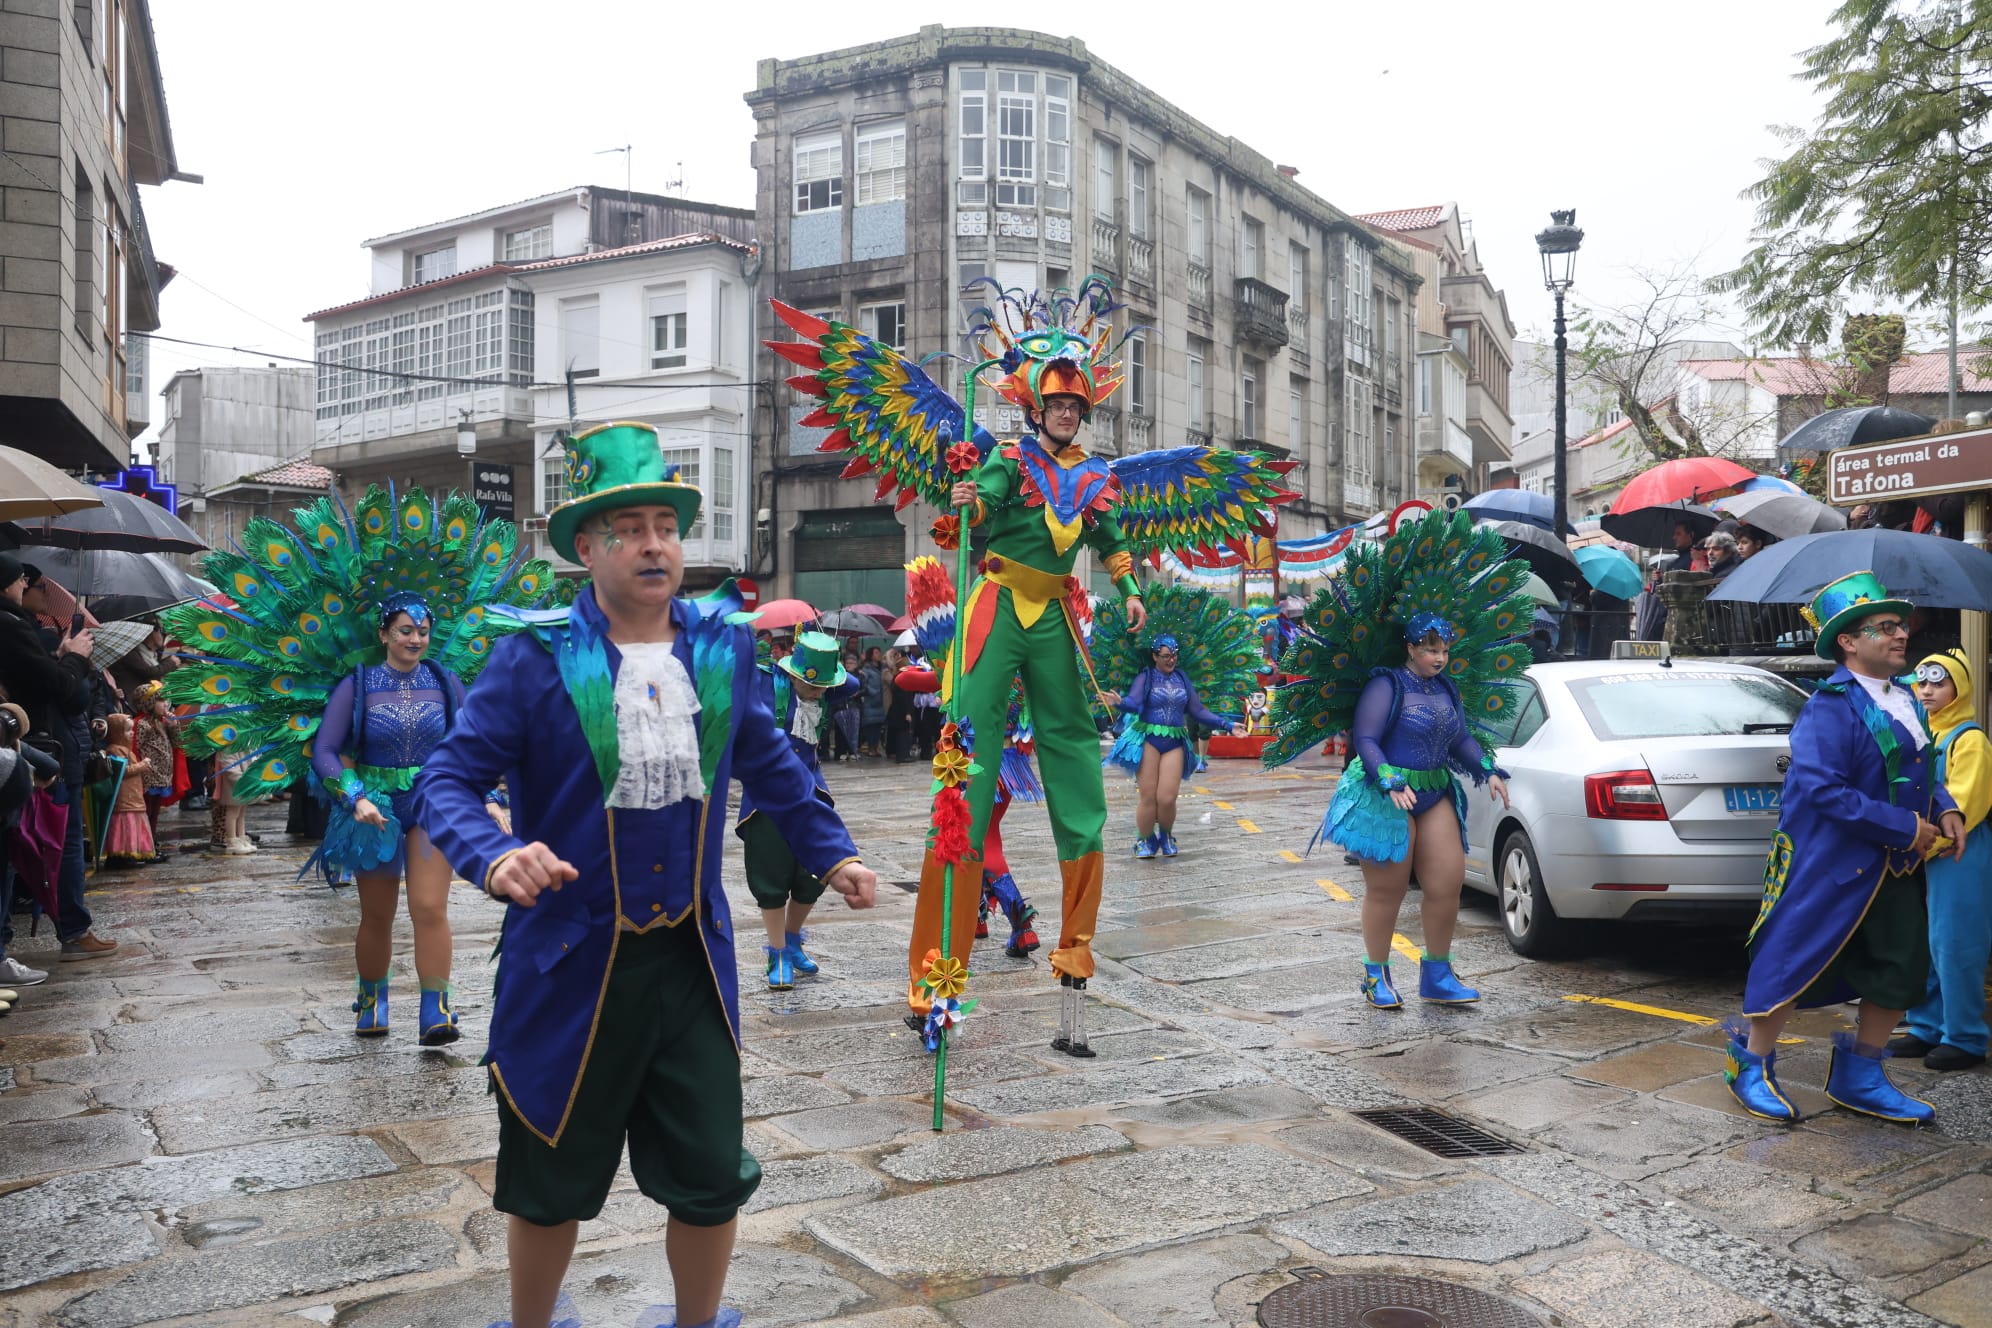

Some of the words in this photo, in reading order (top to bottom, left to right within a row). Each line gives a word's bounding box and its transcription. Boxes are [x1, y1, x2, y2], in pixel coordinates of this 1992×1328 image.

[1837, 457, 1870, 473] área
[1876, 446, 1931, 468] termal
[1937, 444, 1959, 459] da
[1837, 472, 1914, 495] Tafona
[476, 489, 496, 501] Rafa
[496, 490, 513, 502] Vila
[1632, 644, 1660, 656] TAXI
